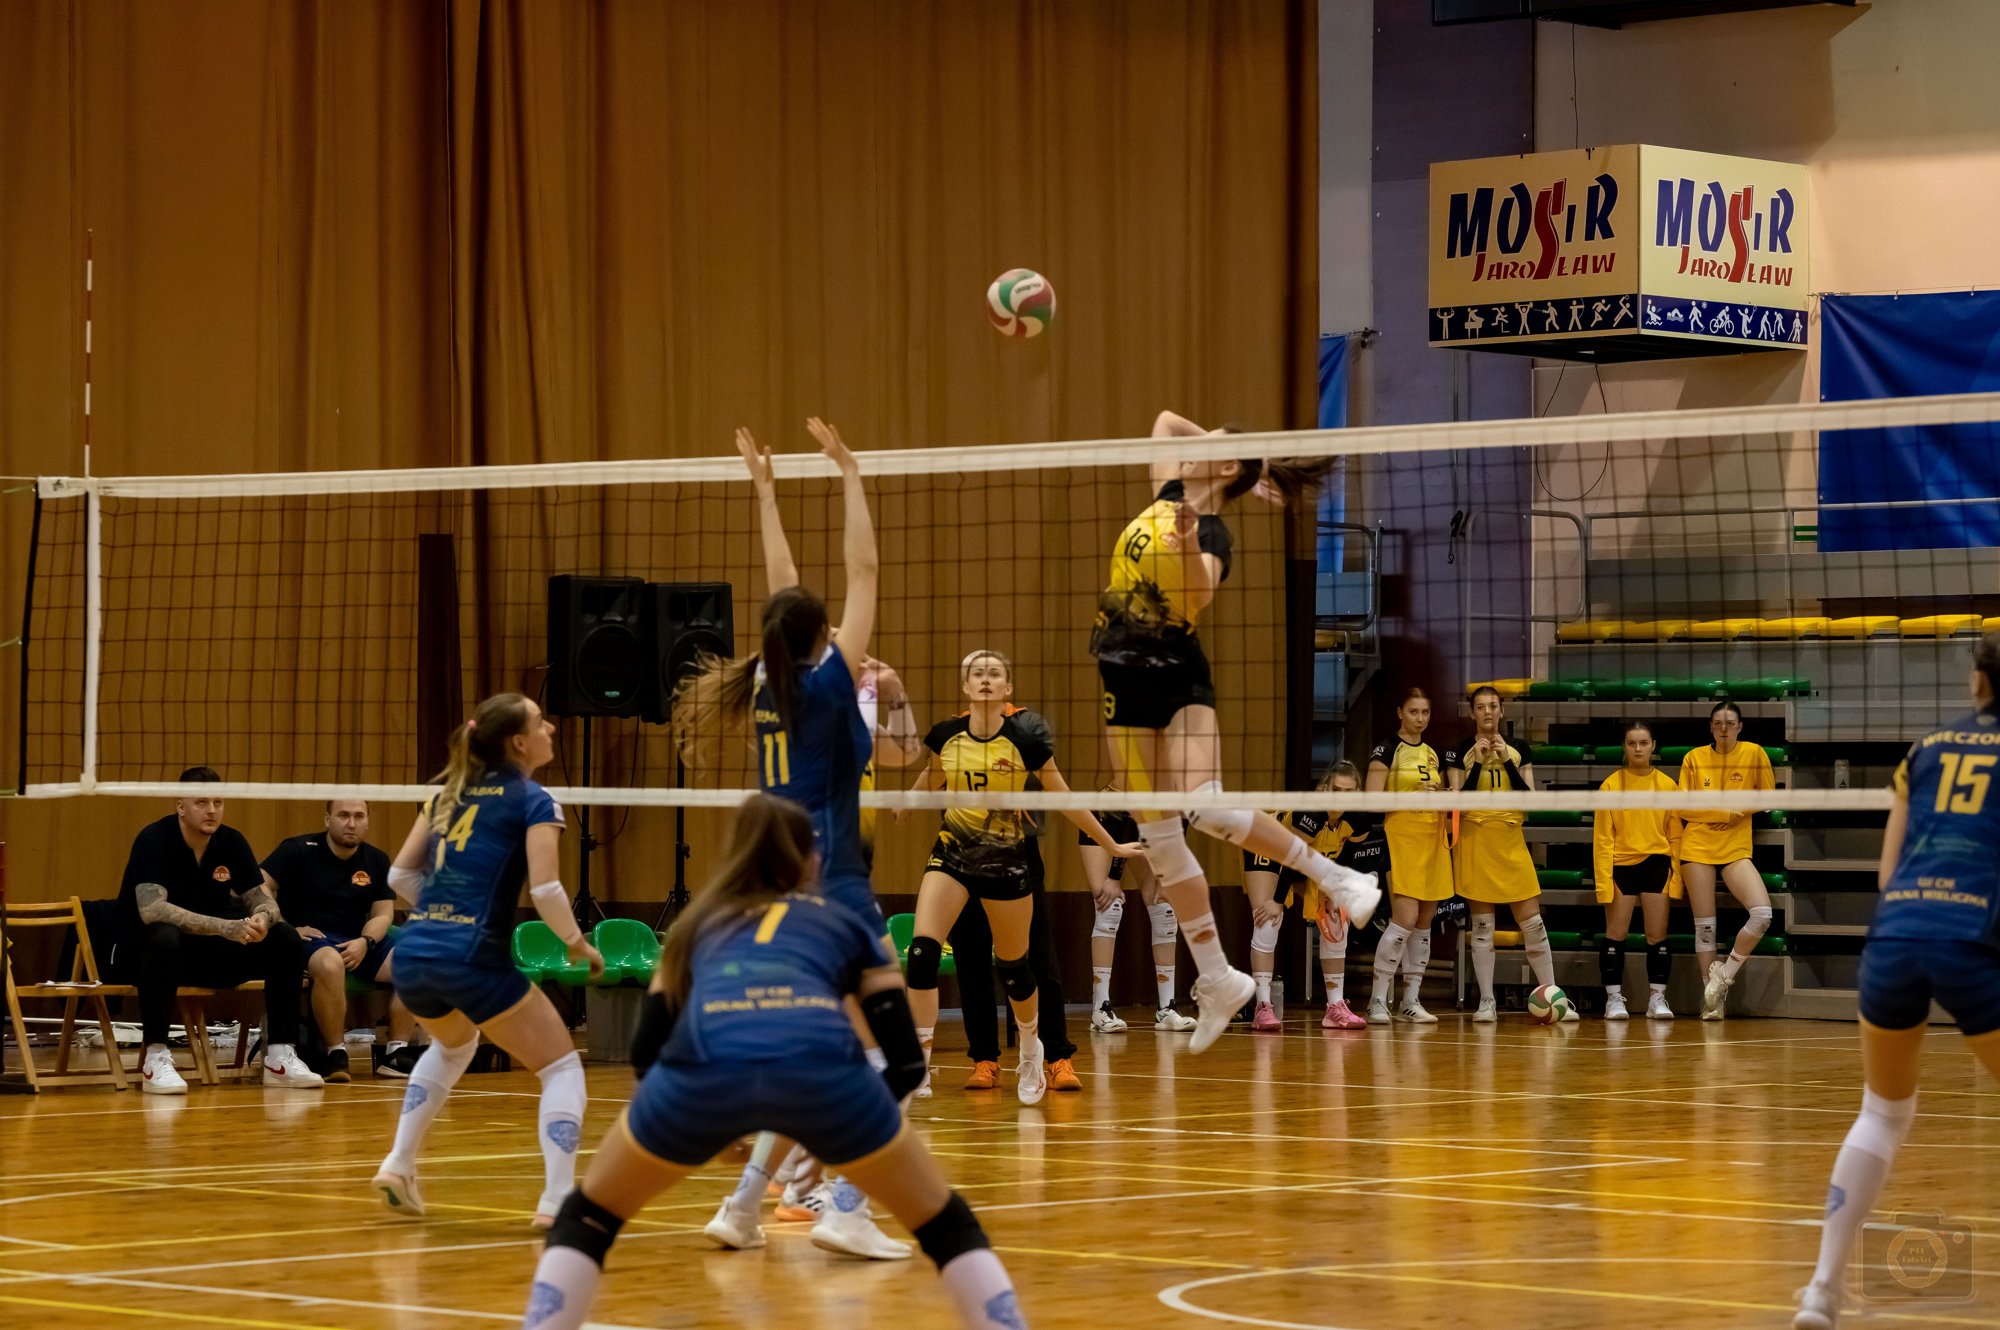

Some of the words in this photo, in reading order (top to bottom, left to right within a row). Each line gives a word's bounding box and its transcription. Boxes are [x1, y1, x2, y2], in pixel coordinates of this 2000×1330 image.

[763, 730, 790, 788] 11
[1417, 765, 1431, 782] 5
[1488, 768, 1502, 788] 11
[1934, 752, 1998, 815] 15
[448, 803, 480, 853] 4
[1366, 847, 1381, 857] PZU
